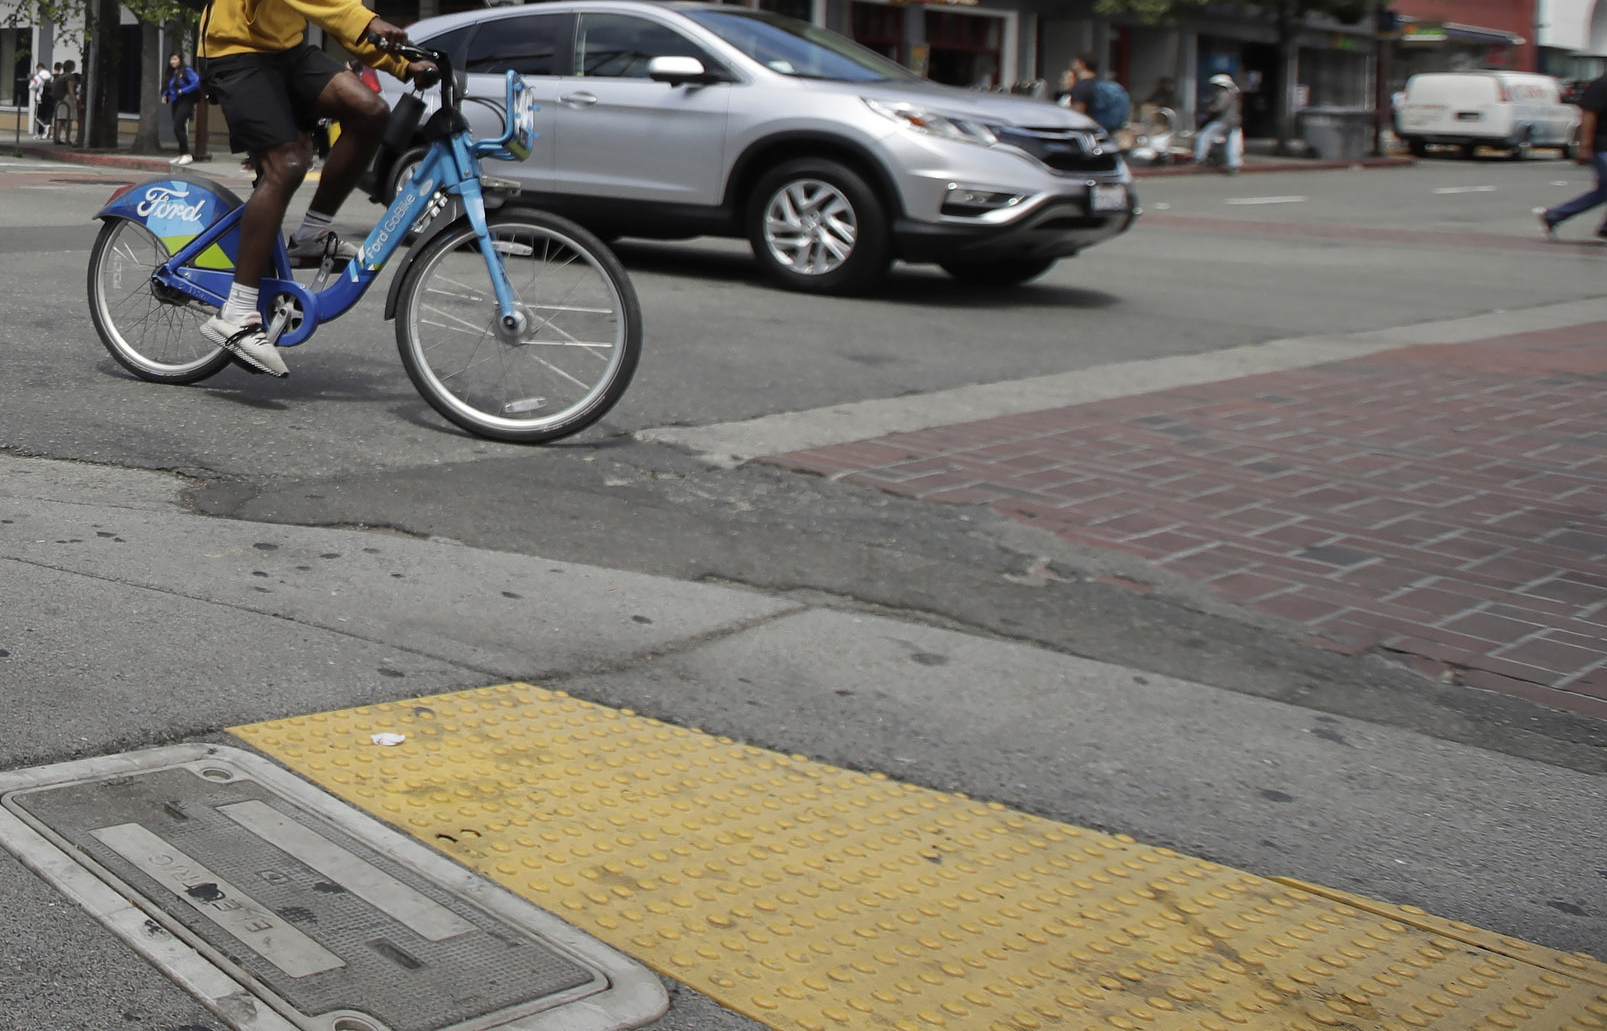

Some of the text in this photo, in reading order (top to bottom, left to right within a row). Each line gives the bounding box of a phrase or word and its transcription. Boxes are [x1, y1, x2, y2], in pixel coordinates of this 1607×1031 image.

[137, 187, 206, 222] Ford
[366, 193, 416, 259] Ford GoBike
